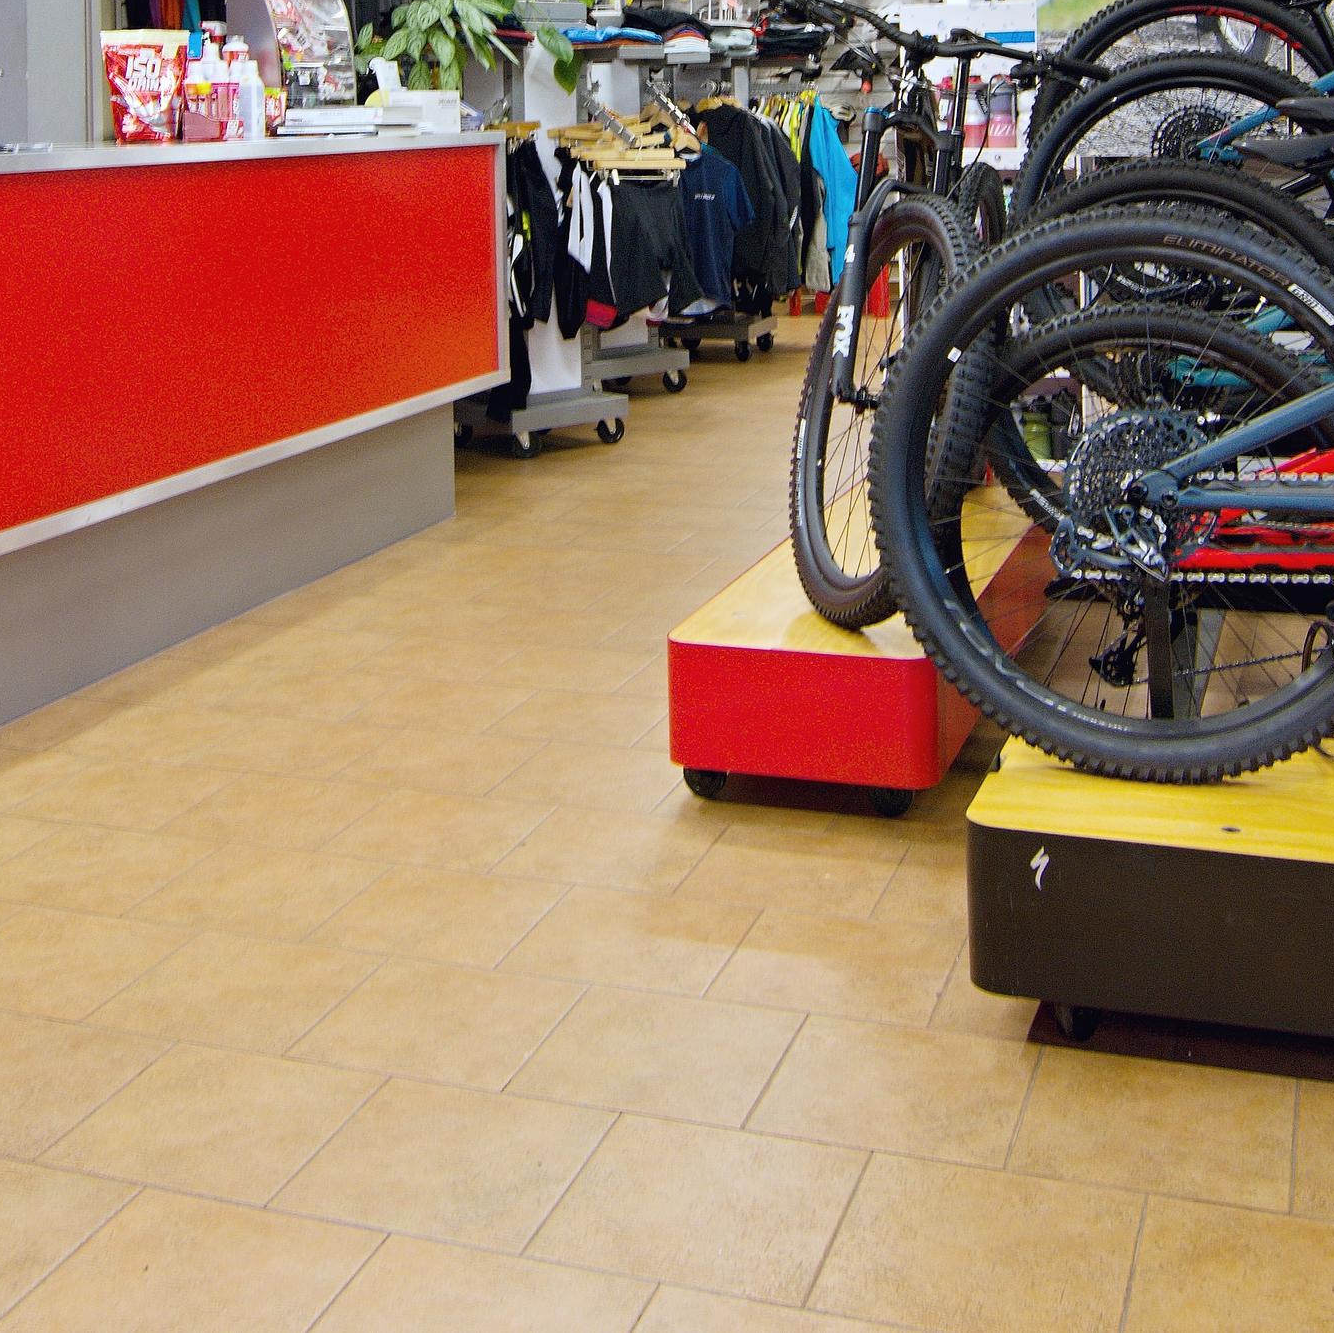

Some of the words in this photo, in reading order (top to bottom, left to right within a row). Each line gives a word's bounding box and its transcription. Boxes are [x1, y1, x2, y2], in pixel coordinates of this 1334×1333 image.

[125, 54, 163, 80] ISO
[1162, 234, 1292, 287] ELIMINATOR
[831, 304, 856, 358] FOX
